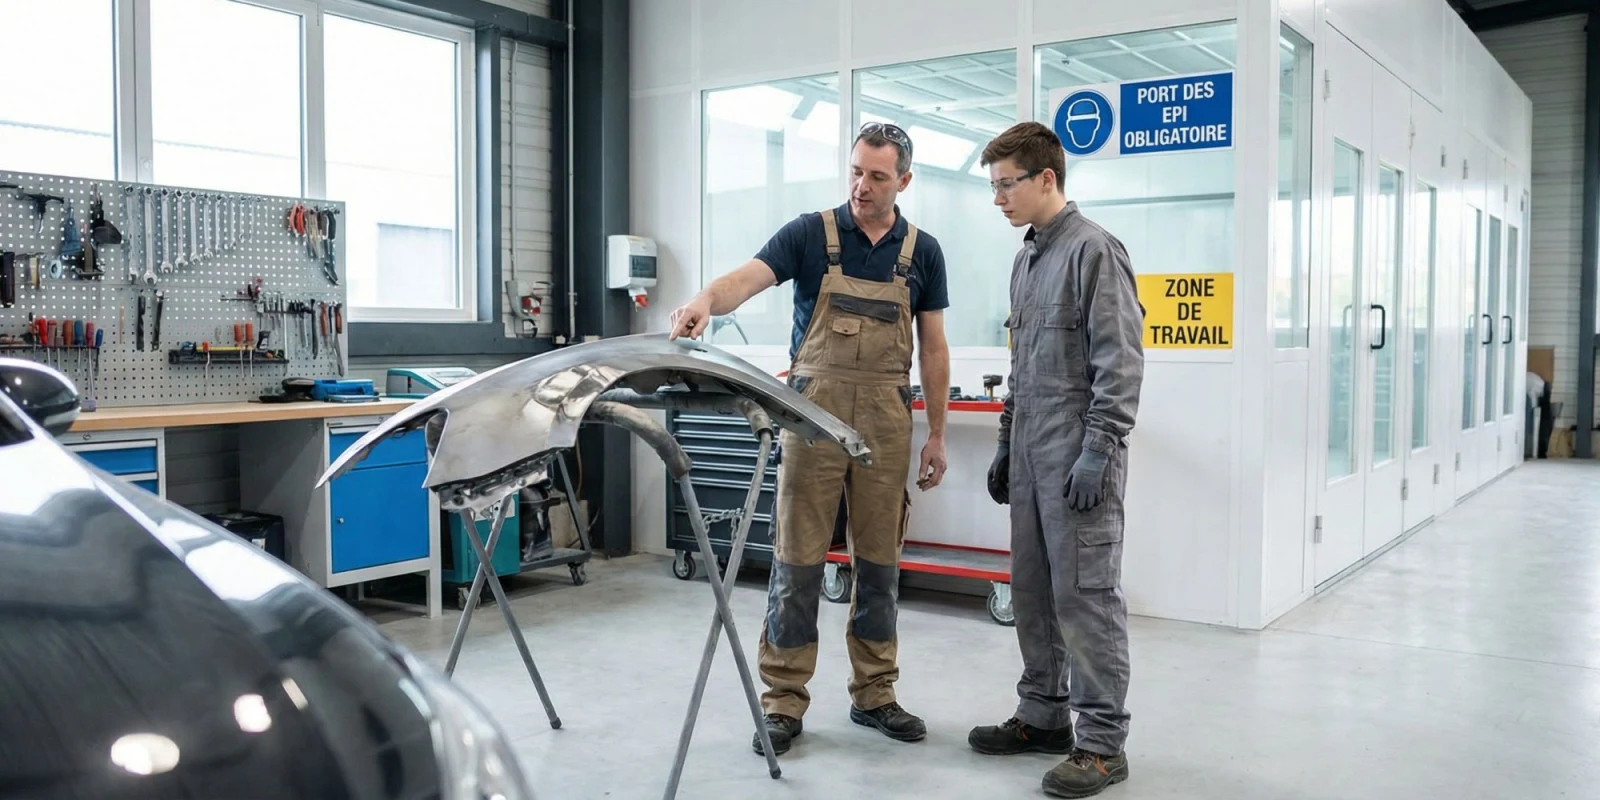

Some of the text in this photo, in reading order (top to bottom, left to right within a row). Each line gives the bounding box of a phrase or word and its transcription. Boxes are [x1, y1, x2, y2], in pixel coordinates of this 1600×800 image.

[1137, 81, 1215, 105] PORT DES
[1162, 105, 1188, 123] EPI
[1124, 124, 1227, 148] OBLIGATOIRE
[1165, 278, 1215, 298] ZONE
[1177, 302, 1202, 321] DE
[1150, 325, 1229, 345] TRAVAIL
